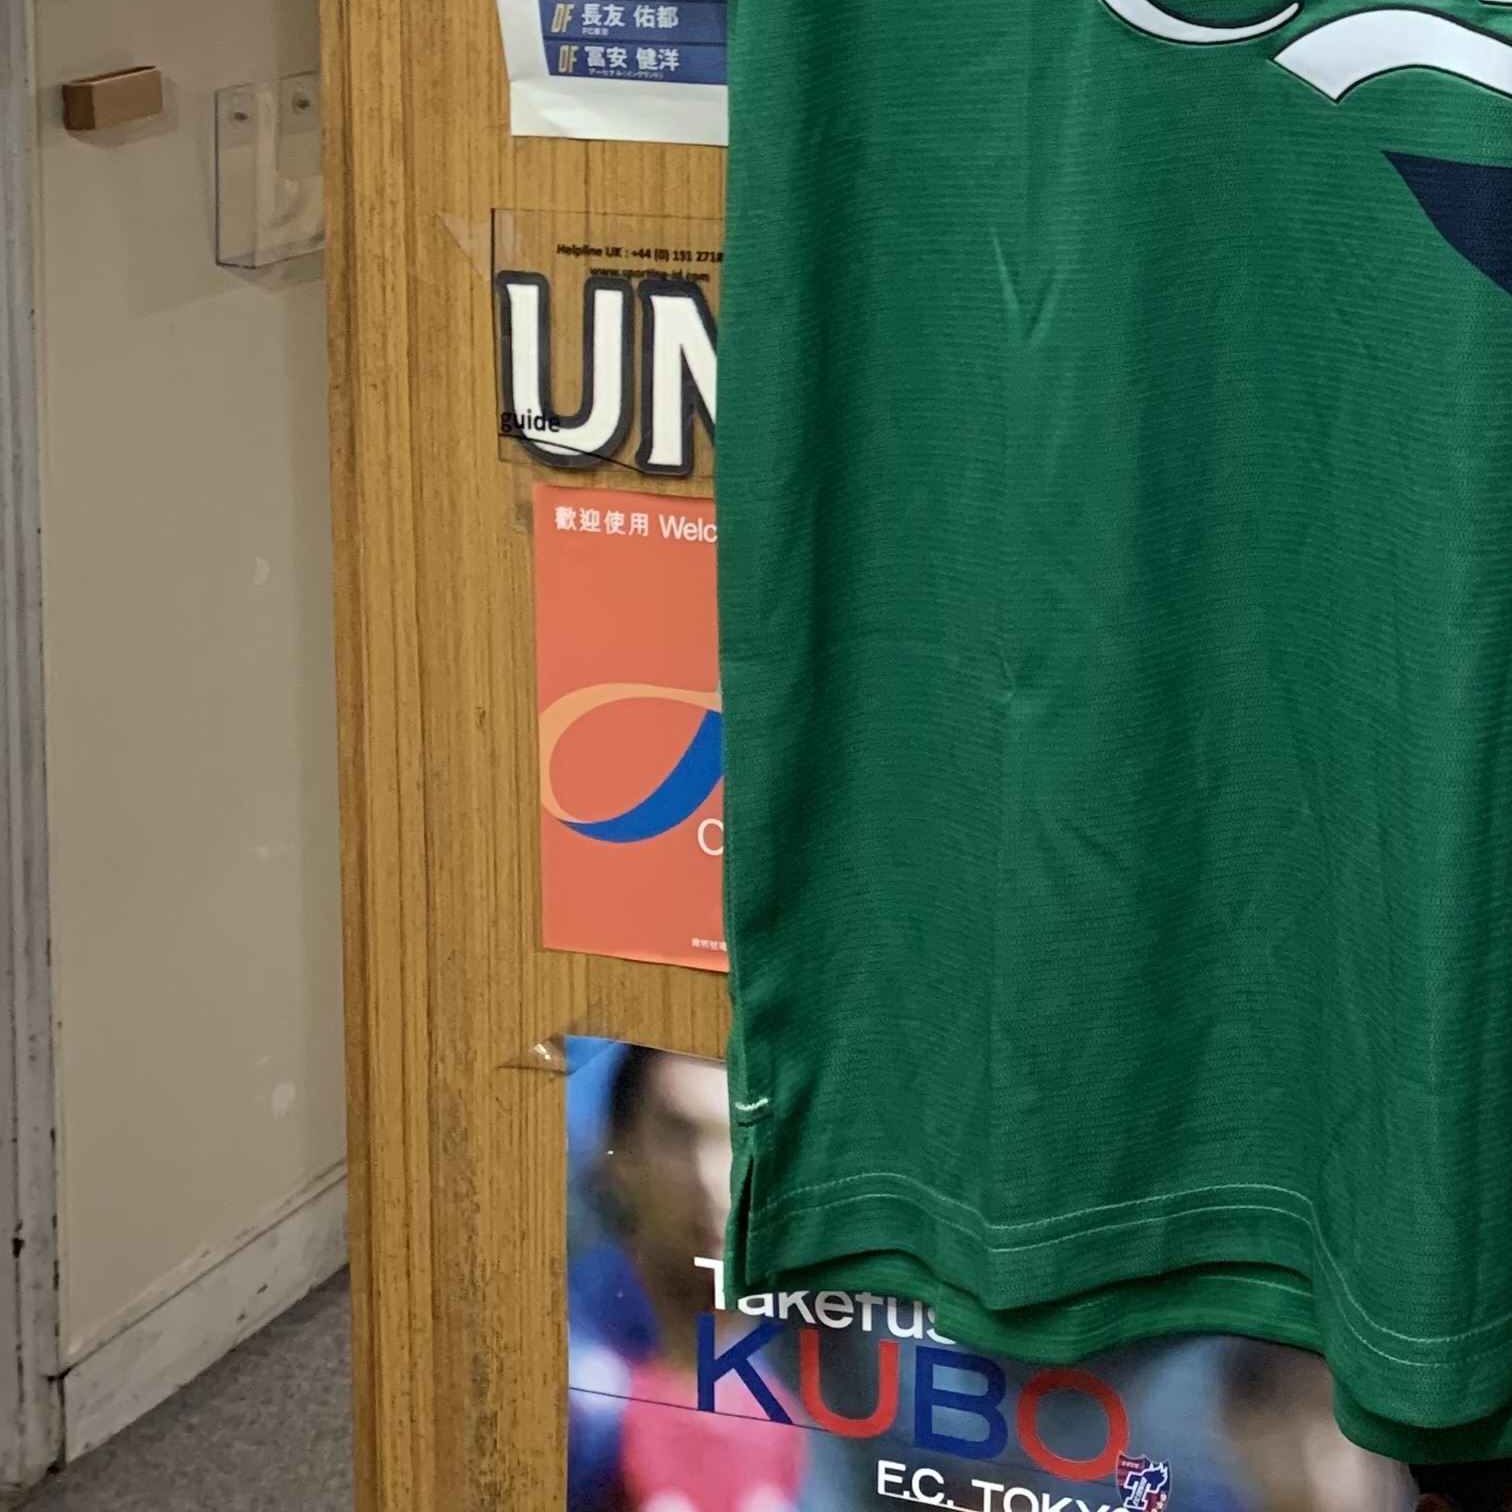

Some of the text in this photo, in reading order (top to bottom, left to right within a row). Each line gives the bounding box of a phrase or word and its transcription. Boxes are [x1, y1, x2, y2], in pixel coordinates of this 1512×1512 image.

[551, 3, 680, 33] DF 長友 佑都
[558, 44, 578, 74] DF
[636, 46, 680, 72] 健洋
[556, 243, 603, 260] Helpline
[605, 246, 623, 259] UK
[632, 248, 652, 261] +44
[499, 408, 561, 433] guide
[554, 504, 650, 537] 歡迎使用
[695, 1311, 1130, 1482] KUBO
